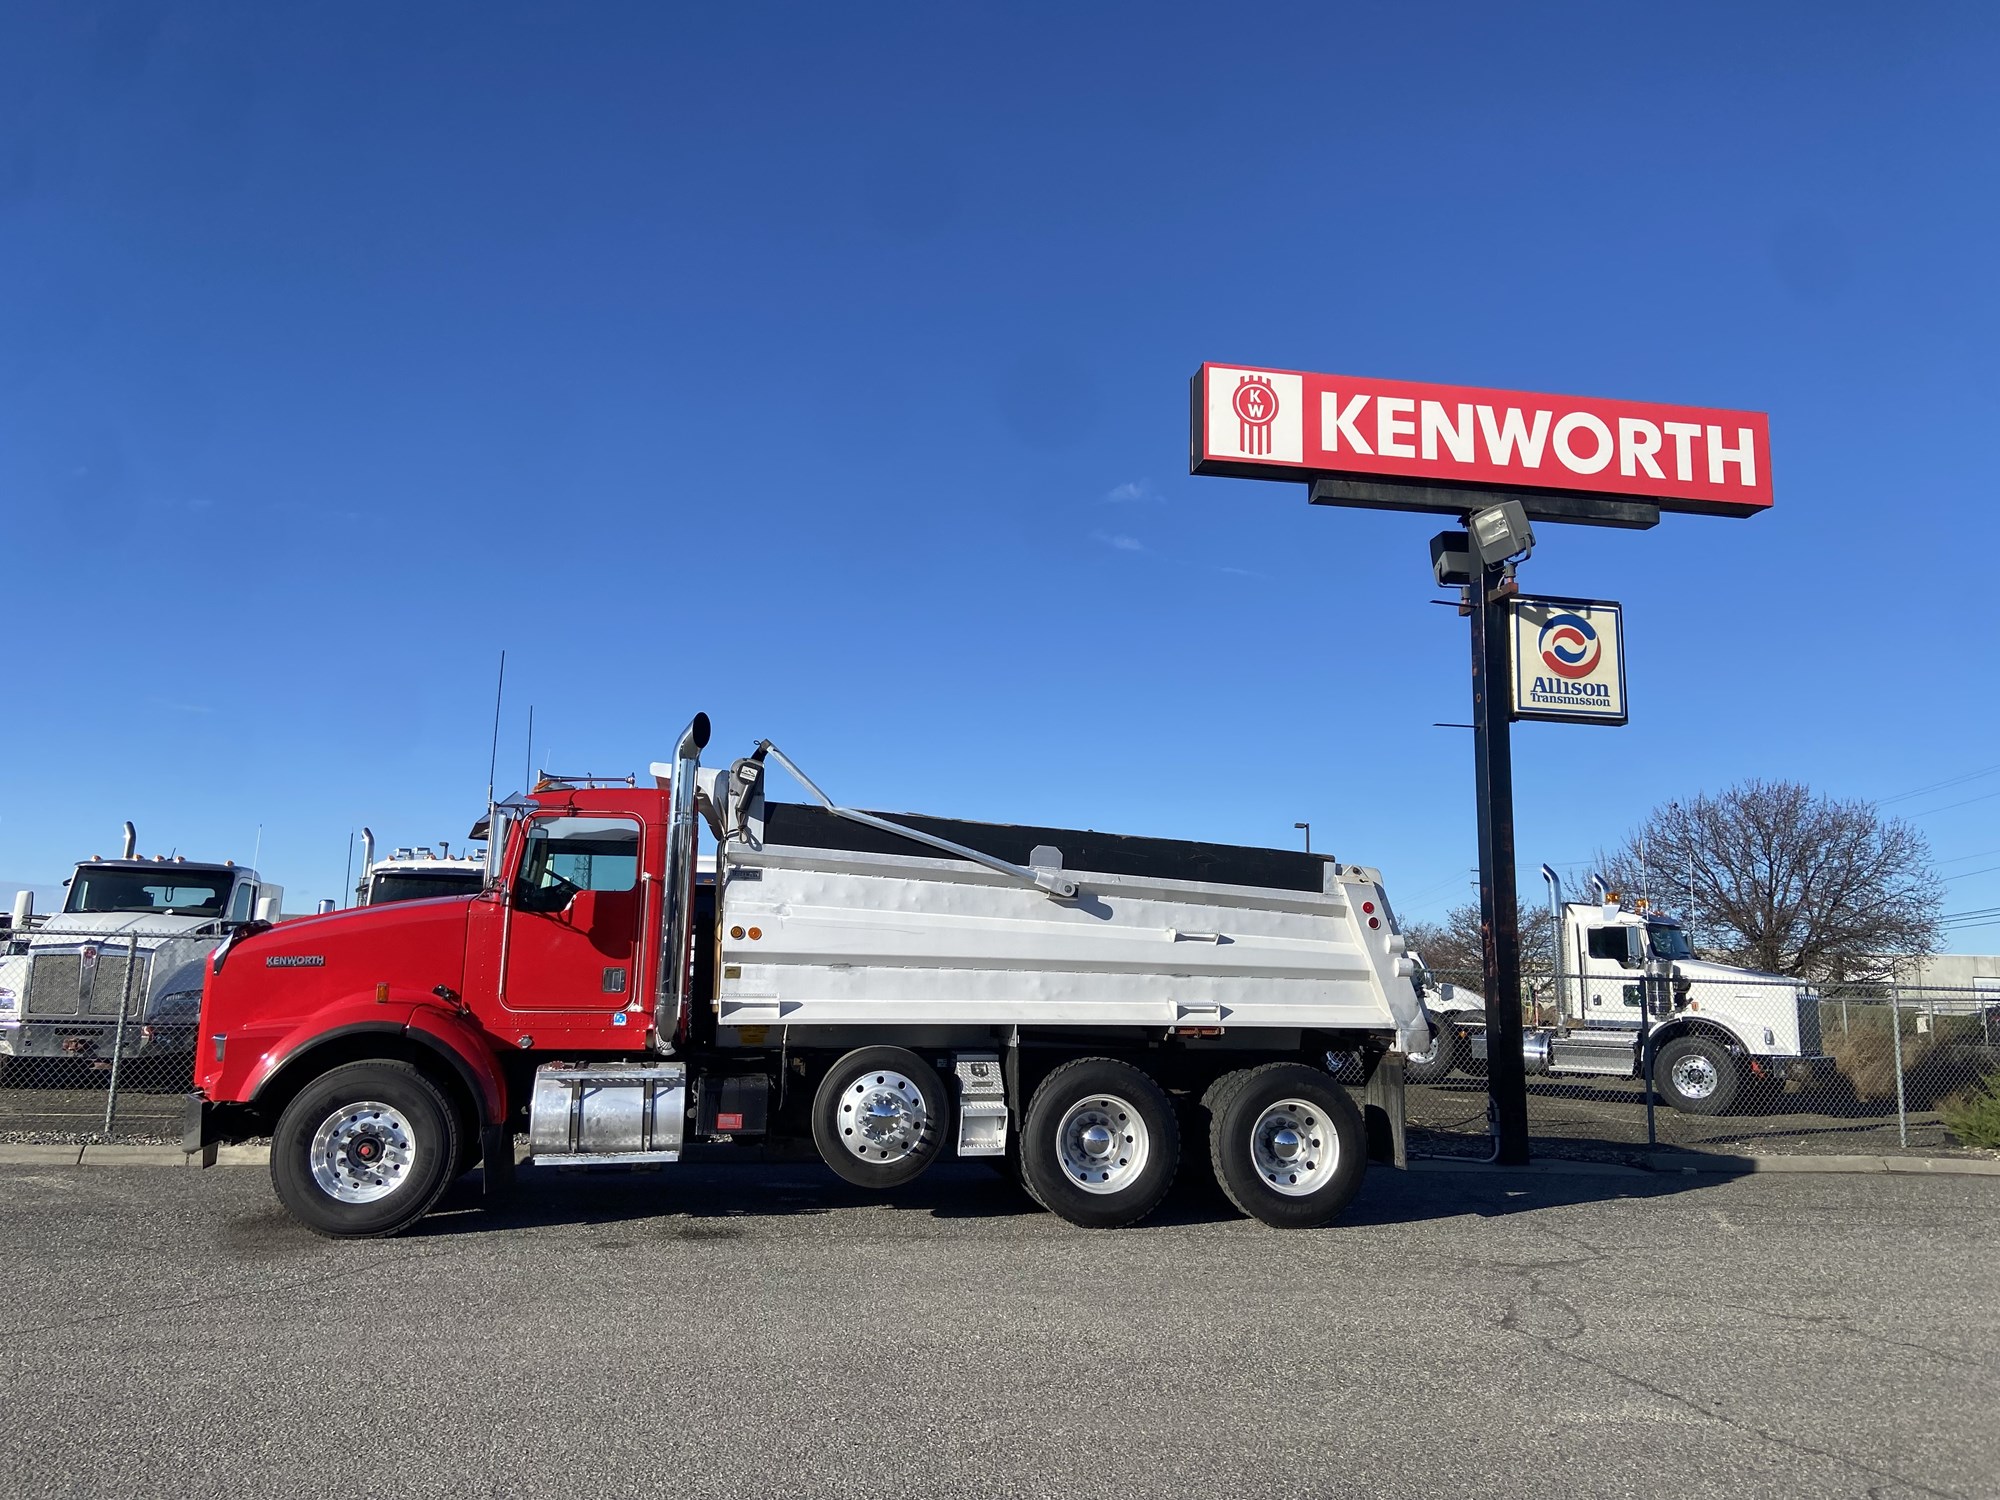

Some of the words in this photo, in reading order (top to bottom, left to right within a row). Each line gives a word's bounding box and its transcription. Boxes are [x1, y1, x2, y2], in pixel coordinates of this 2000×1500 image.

[1250, 389, 1262, 403] K
[1248, 404, 1265, 418] W
[1321, 391, 1757, 486] KENWORTH
[1530, 676, 1610, 698] Allison
[1530, 692, 1611, 707] Transmission
[266, 955, 325, 966] KENWORTH
